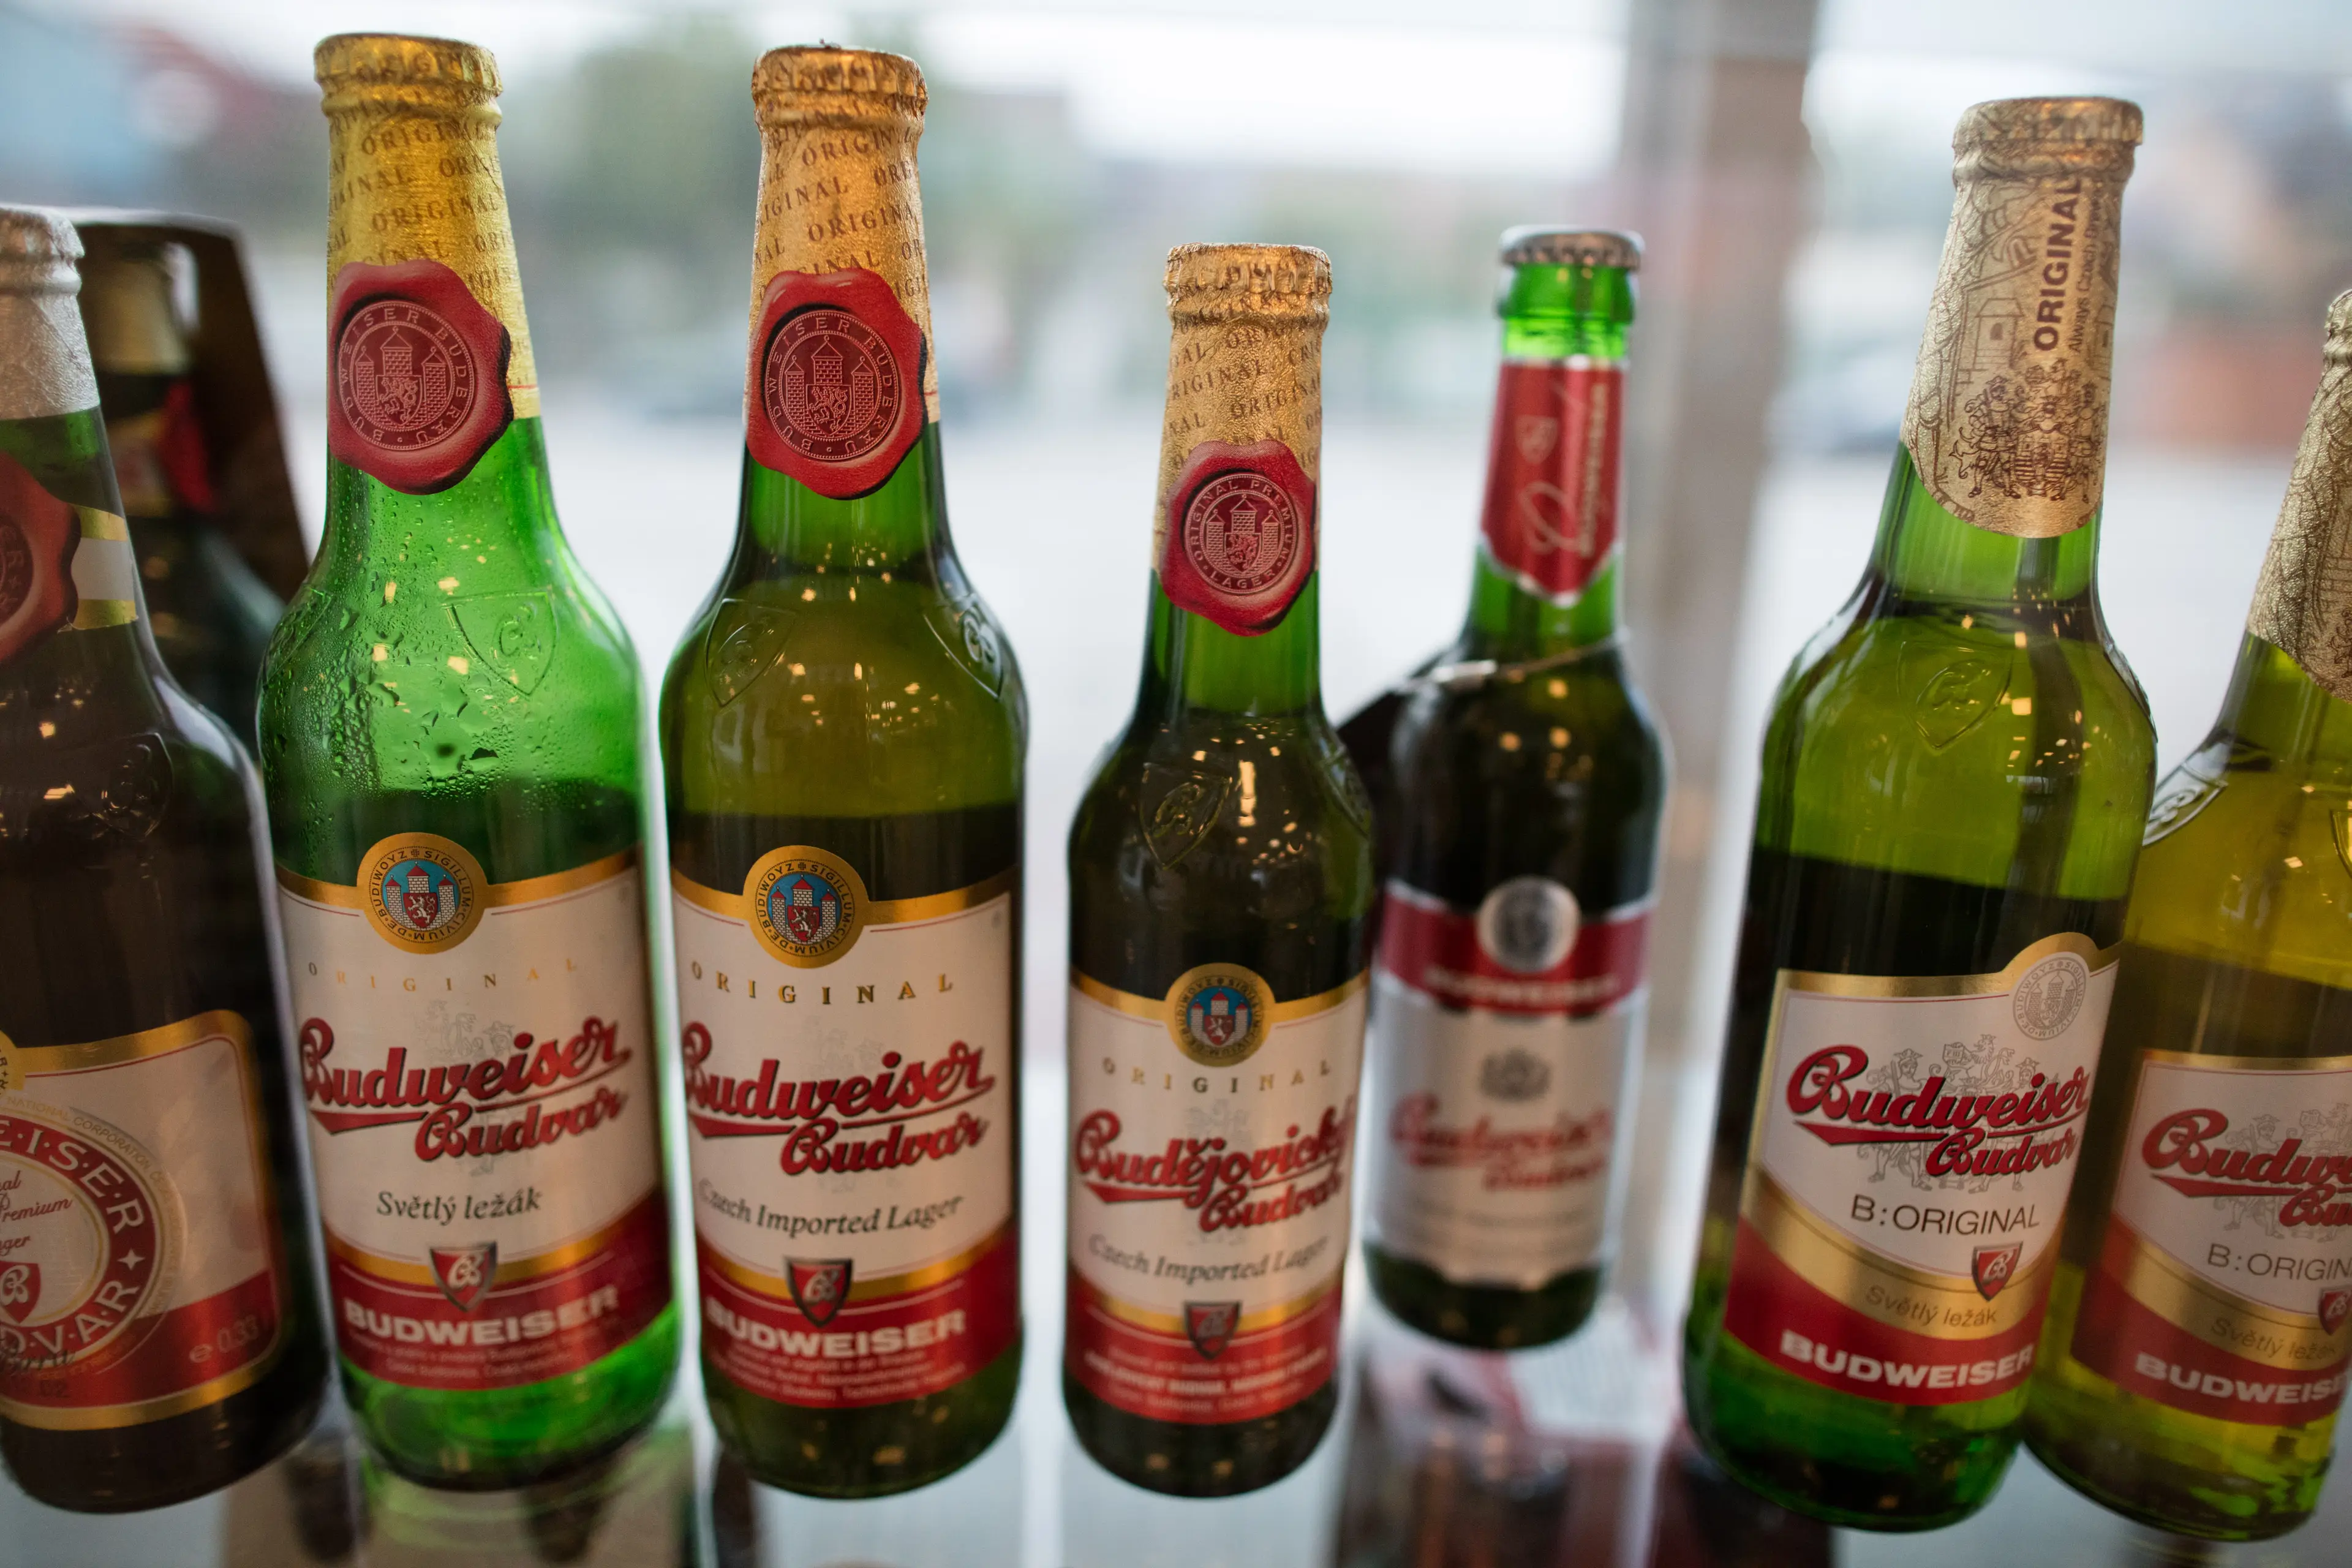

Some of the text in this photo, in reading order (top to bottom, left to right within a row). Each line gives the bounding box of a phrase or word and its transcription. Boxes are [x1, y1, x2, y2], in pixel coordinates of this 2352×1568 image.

[2034, 179, 2081, 352] ORIGINAL
[340, 307, 420, 440] BUDWEISER
[769, 317, 851, 450] BUDWEISER
[1191, 479, 1293, 589] ORIGINAL PREMIUM LAGER
[371, 850, 472, 941] SIGILLUM CIVIUM DE BUDIWOYZ
[757, 862, 854, 954] SIGILLUM CIVIUM DE BUDIWOYZ
[308, 957, 578, 992] ORIGINAL
[691, 960, 953, 1005] ORIGINAL
[2016, 962, 2054, 1020] BUDIWOYZ
[2021, 1022, 2036, 1035] DE
[300, 1016, 631, 1107] Budweiser
[682, 1020, 997, 1120] Budweiser
[1102, 1057, 1330, 1093] ORIGINAL
[1785, 1045, 2092, 1129] Budweiser
[74, 1116, 151, 1172] CORPORATION
[415, 1087, 629, 1163] Budvar
[780, 1110, 989, 1176] Budvar
[1925, 1127, 2078, 1177] Budvar
[375, 1185, 545, 1227] Světlý ležák
[697, 1178, 964, 1239] Czech Imported Lager
[1850, 1193, 2040, 1236] B:ORIGINAL
[1088, 1234, 1330, 1285] Czech Imported Lager
[342, 1283, 619, 1346] BUDWEISER
[704, 1295, 967, 1359] BUDWEISER
[1864, 1285, 1997, 1328] Světlý ležák
[1779, 1328, 2034, 1390] BUDWEISER
